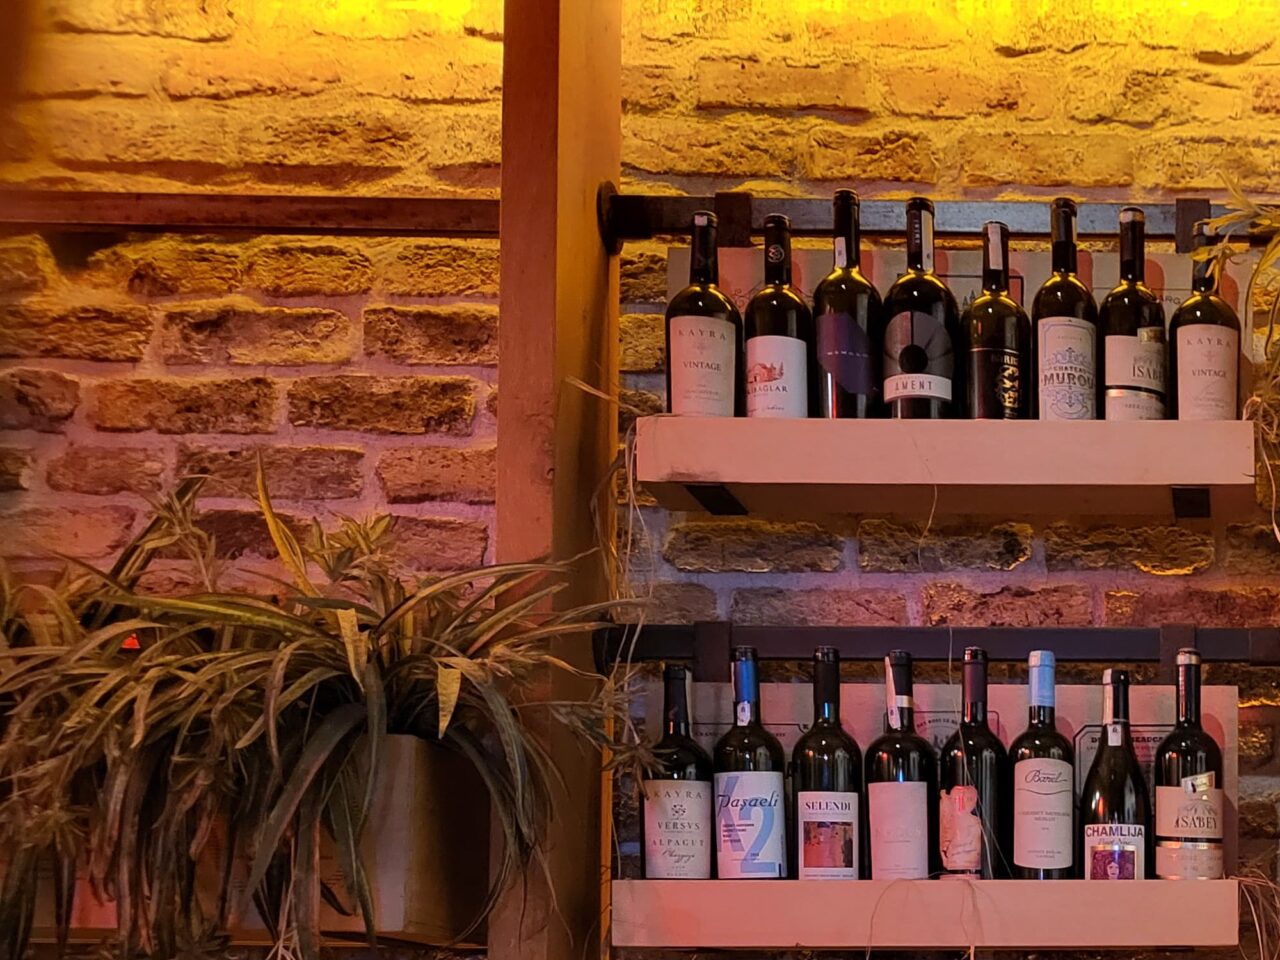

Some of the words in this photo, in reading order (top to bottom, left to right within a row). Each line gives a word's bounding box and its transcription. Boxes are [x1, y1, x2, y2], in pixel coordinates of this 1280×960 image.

[679, 329, 727, 341] KAYRA
[683, 361, 721, 371] VINTAGE
[805, 801, 851, 811] SELENDI
[1086, 826, 1144, 837] CHAMLIJA
